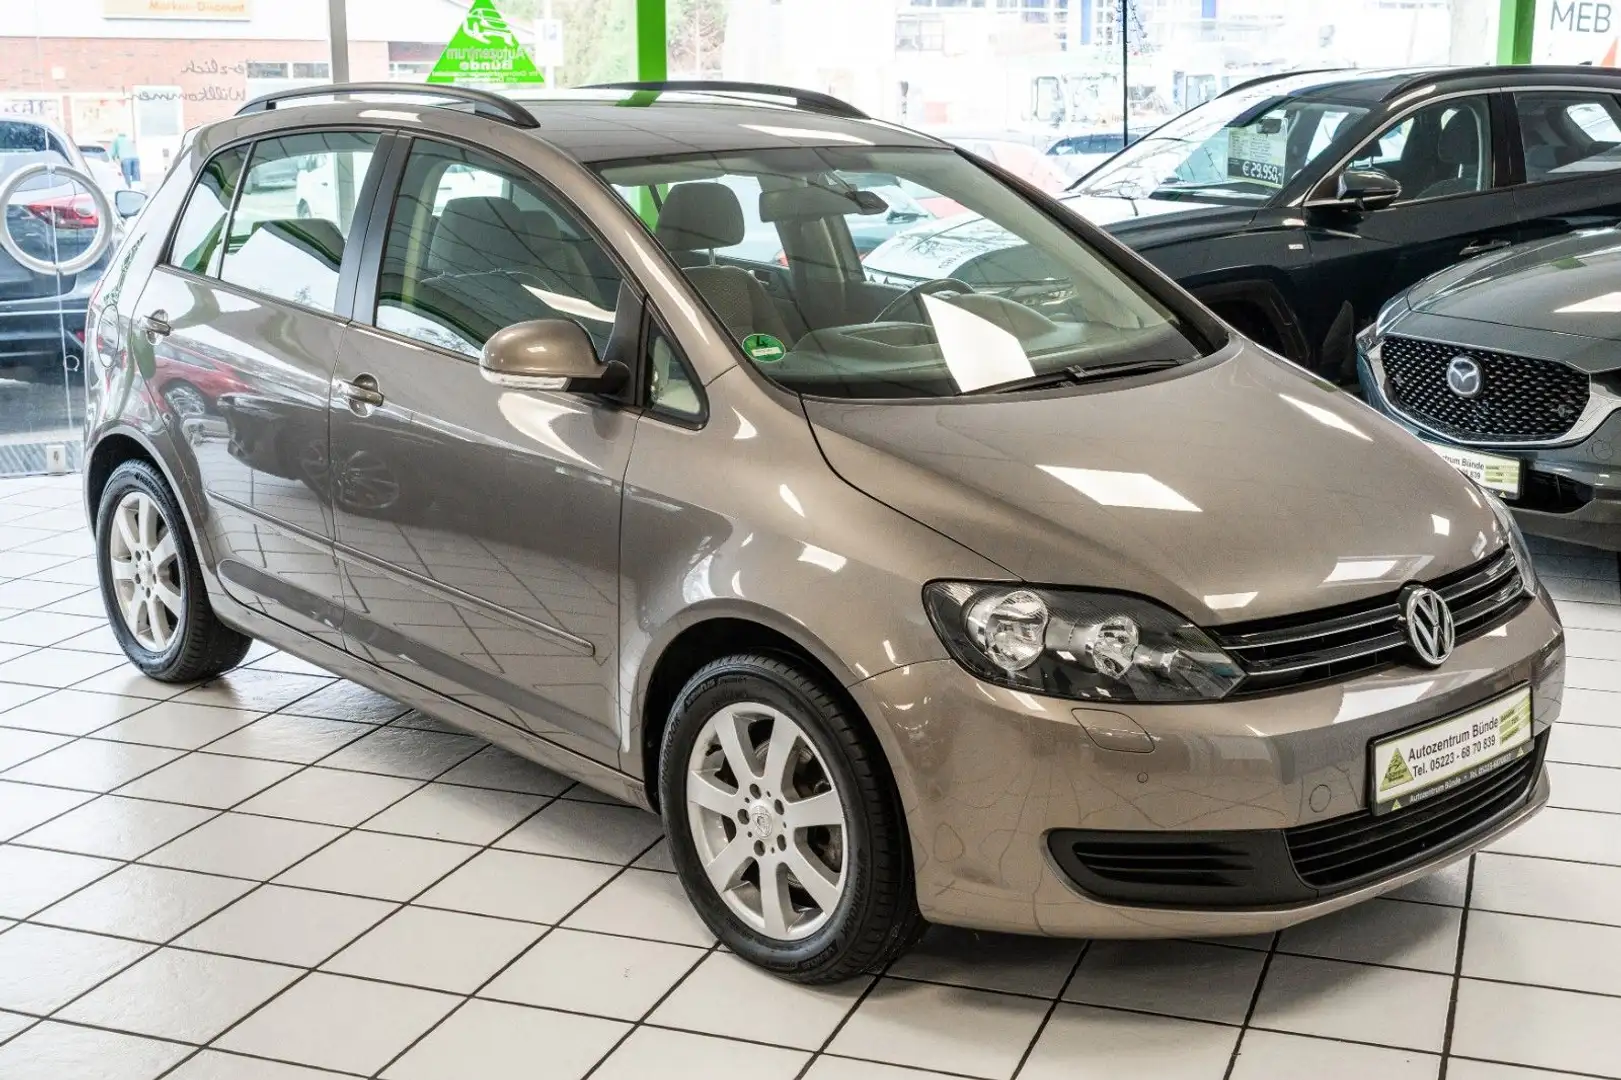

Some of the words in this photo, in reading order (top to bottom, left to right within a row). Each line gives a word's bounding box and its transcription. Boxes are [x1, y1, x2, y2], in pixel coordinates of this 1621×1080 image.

[1408, 729, 1470, 762] Autozentrum
[1472, 715, 1499, 738] Bünde
[1412, 762, 1428, 778] Tel.
[1430, 753, 1455, 772] 05223
[1461, 746, 1471, 759] 68
[1472, 741, 1482, 755] 70
[1483, 735, 1496, 750] 839
[1409, 784, 1444, 804] Autozentrum
